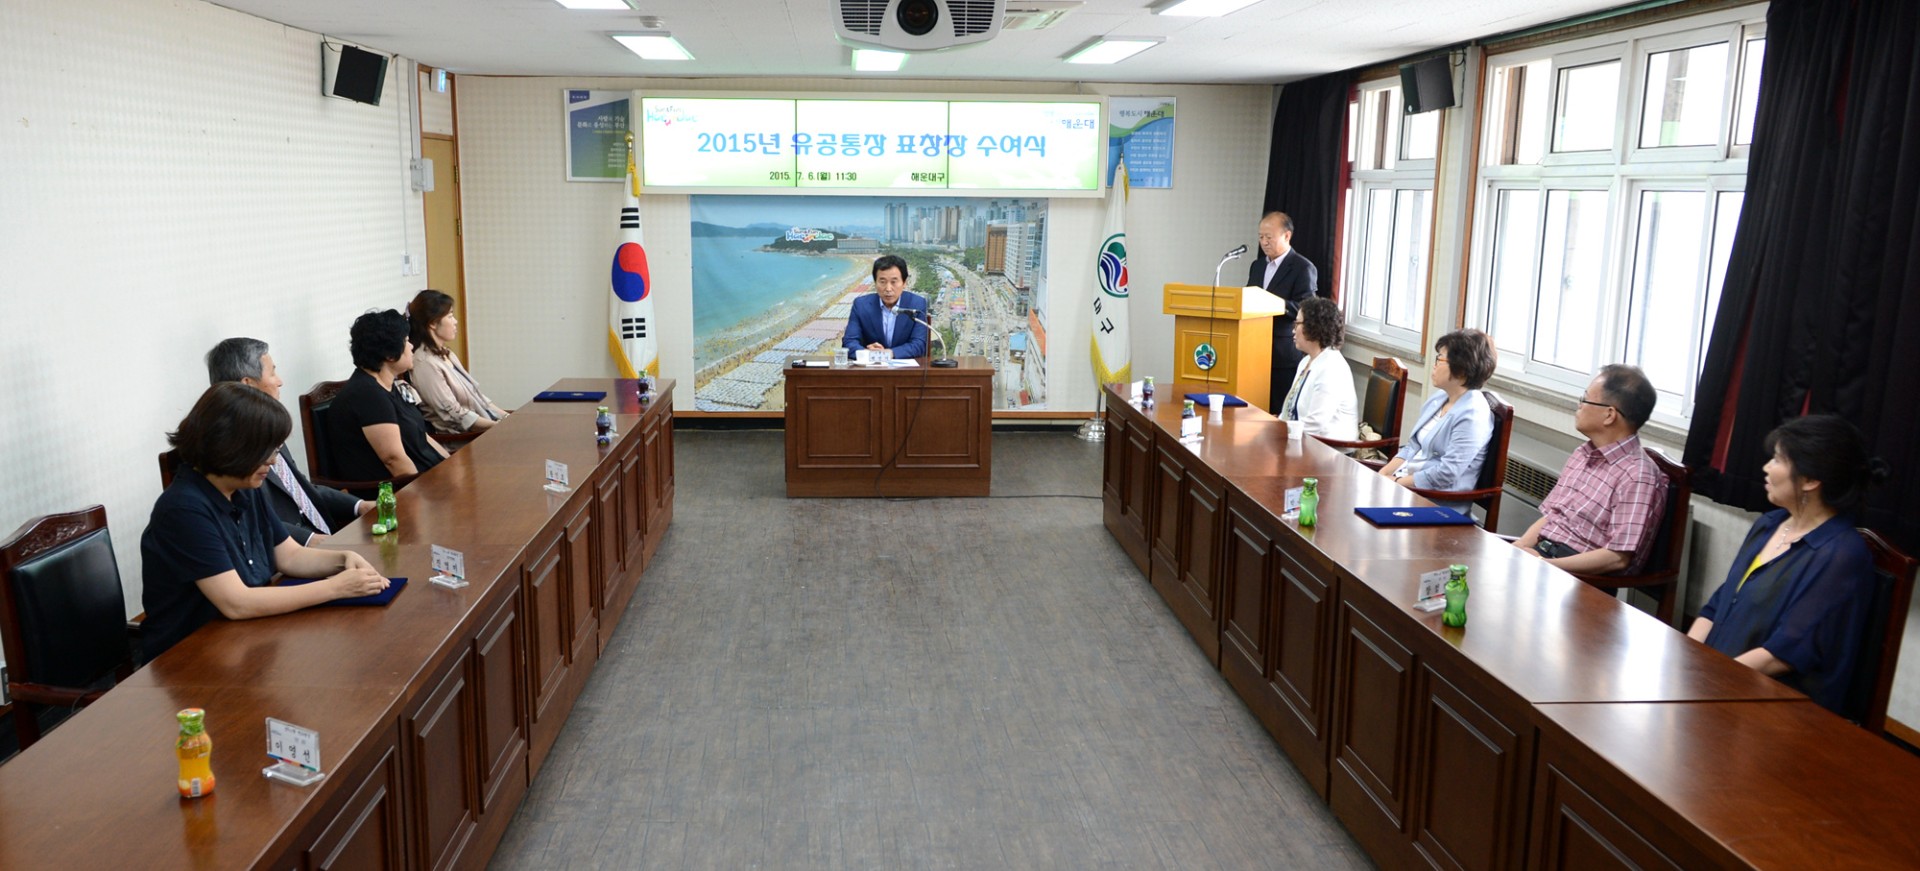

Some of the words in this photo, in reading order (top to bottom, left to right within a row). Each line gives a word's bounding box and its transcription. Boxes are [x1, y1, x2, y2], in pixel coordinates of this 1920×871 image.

[697, 132, 780, 155] 2015년
[791, 132, 887, 157] 유공통장
[896, 133, 968, 157] 표창장
[976, 135, 1046, 158] 수여식
[769, 172, 791, 181] 2015.
[836, 172, 857, 181] 11:30
[911, 172, 945, 182] 해운대구
